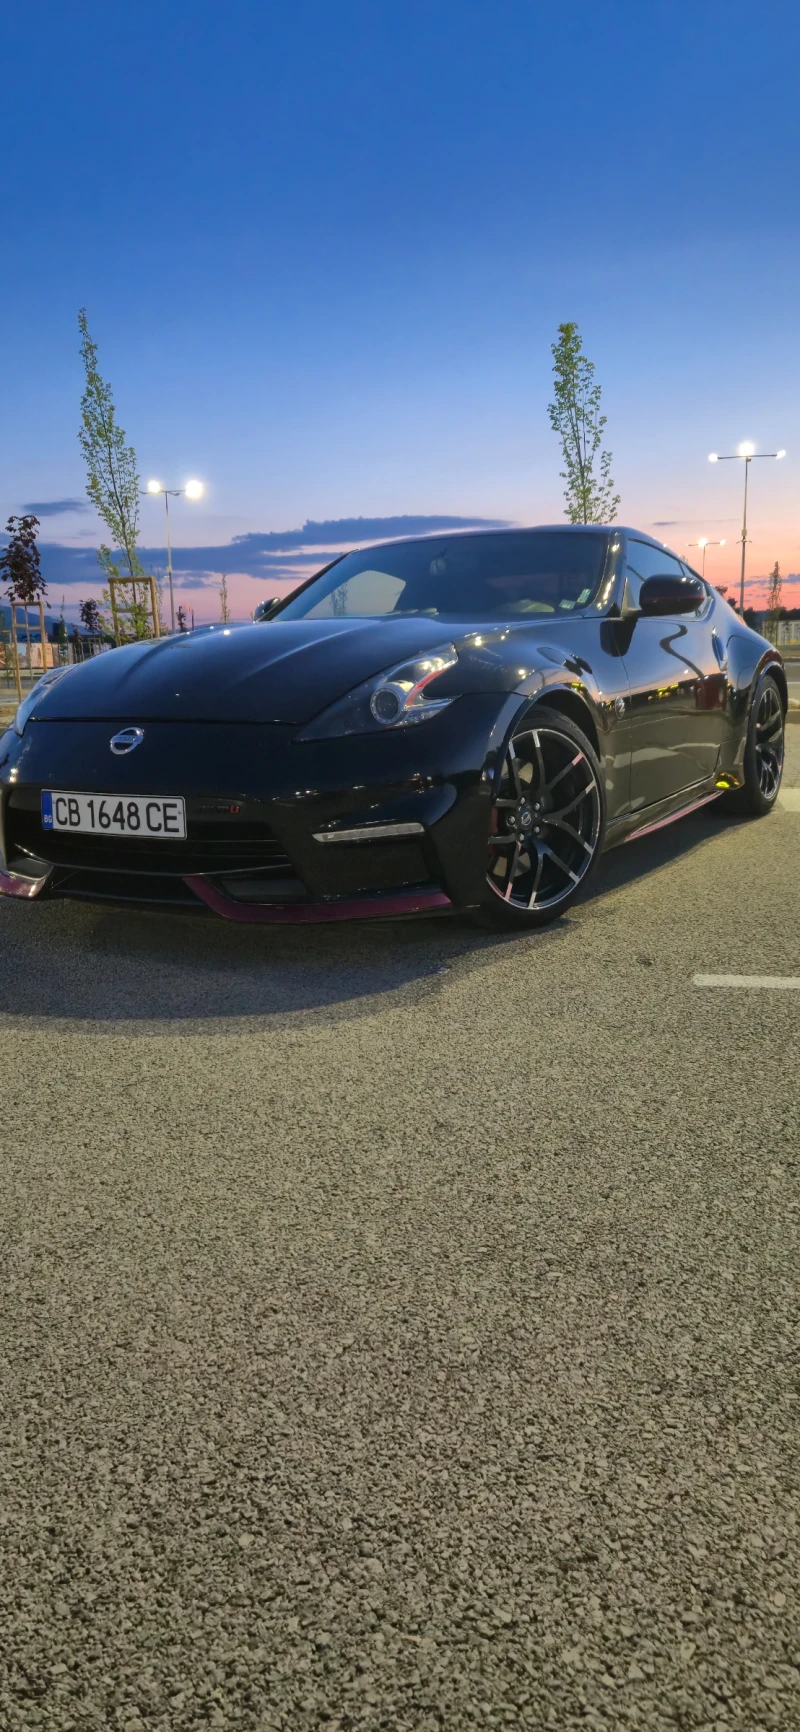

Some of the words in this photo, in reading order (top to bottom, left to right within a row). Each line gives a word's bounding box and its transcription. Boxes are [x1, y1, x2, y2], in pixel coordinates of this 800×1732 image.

[44, 814, 52, 823] BG
[55, 797, 81, 827] CB
[87, 800, 141, 831] 1648
[146, 802, 179, 833] CE
